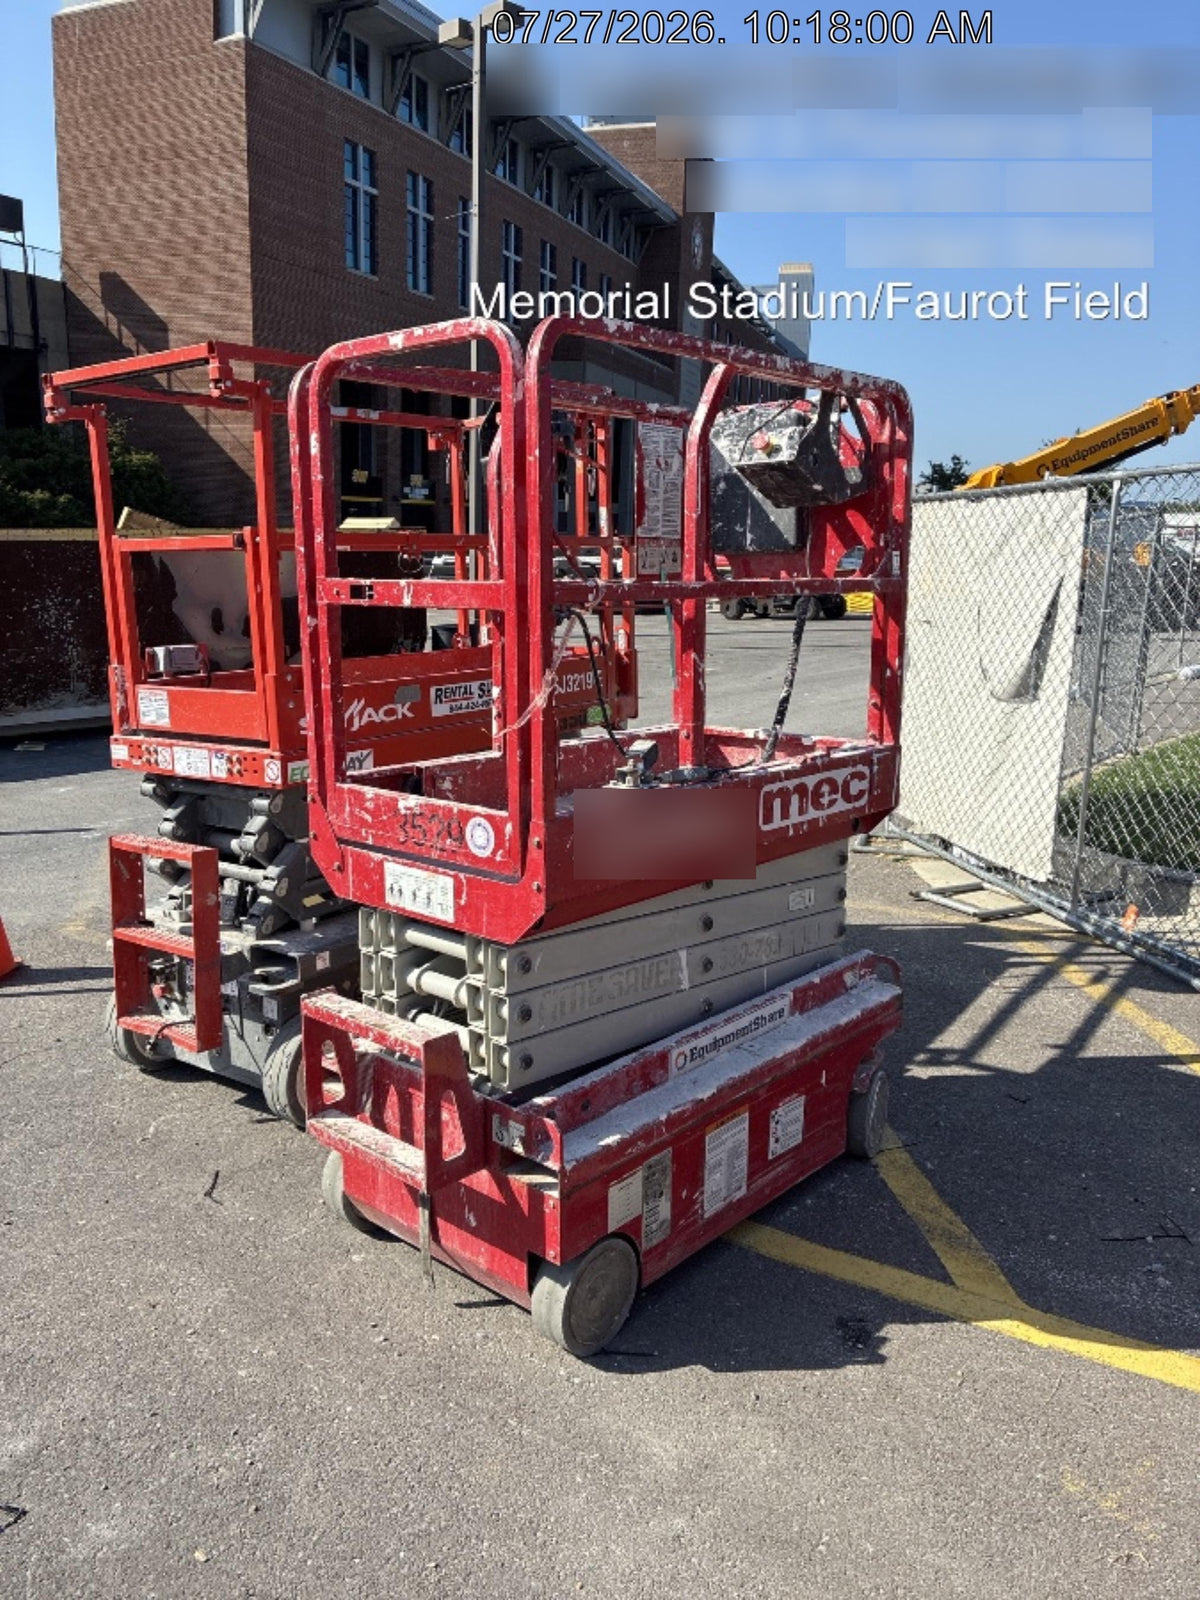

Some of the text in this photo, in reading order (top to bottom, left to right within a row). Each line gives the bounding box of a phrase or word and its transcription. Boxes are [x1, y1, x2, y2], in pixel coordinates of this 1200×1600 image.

[1051, 417, 1160, 472] EquipmentShare
[434, 684, 474, 704] RENTAL
[762, 770, 868, 826] mec
[689, 1007, 786, 1064] EquipmentShare
